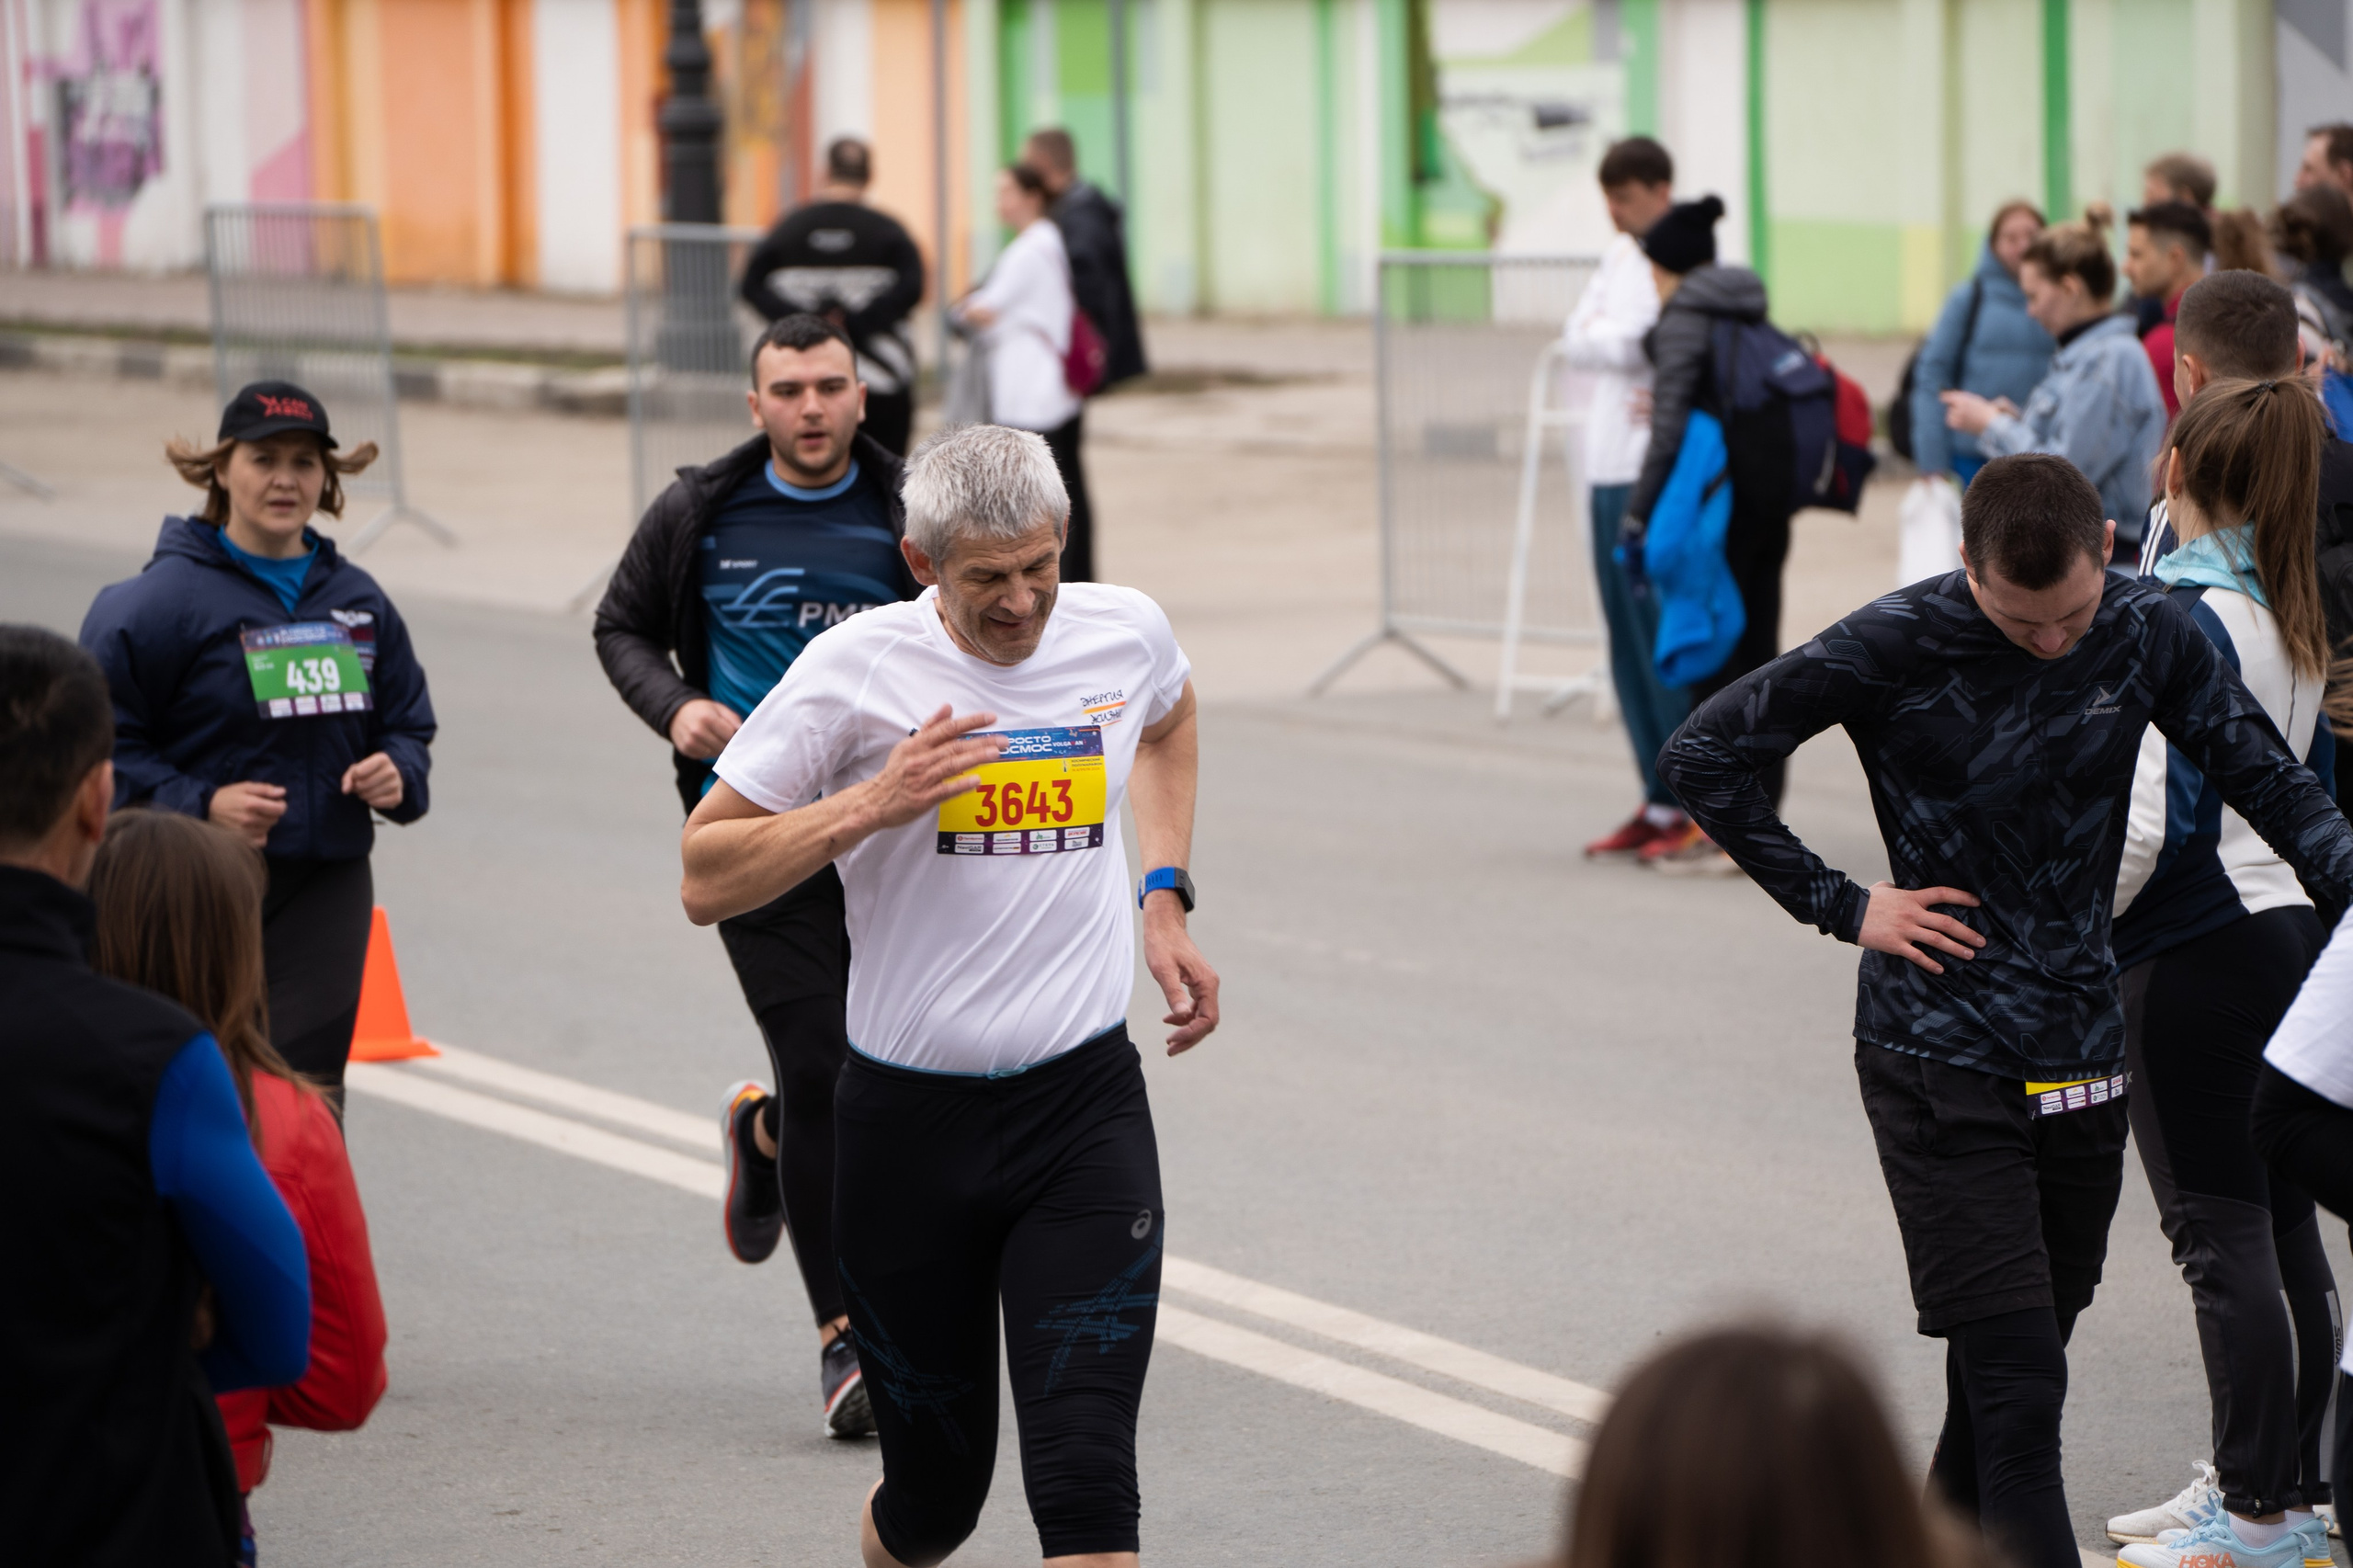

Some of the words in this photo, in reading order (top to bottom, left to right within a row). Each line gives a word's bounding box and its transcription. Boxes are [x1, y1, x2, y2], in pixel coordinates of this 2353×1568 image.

[286, 657, 341, 694] 439
[1080, 689, 1124, 707] ЭНЕРГИЯ
[2085, 705, 2121, 714] DEMIX
[1006, 735, 1051, 744] РОСТО
[999, 744, 1052, 754] ОСМОС
[975, 778, 1074, 827] 3643
[2178, 1551, 2237, 1568] HOKA
